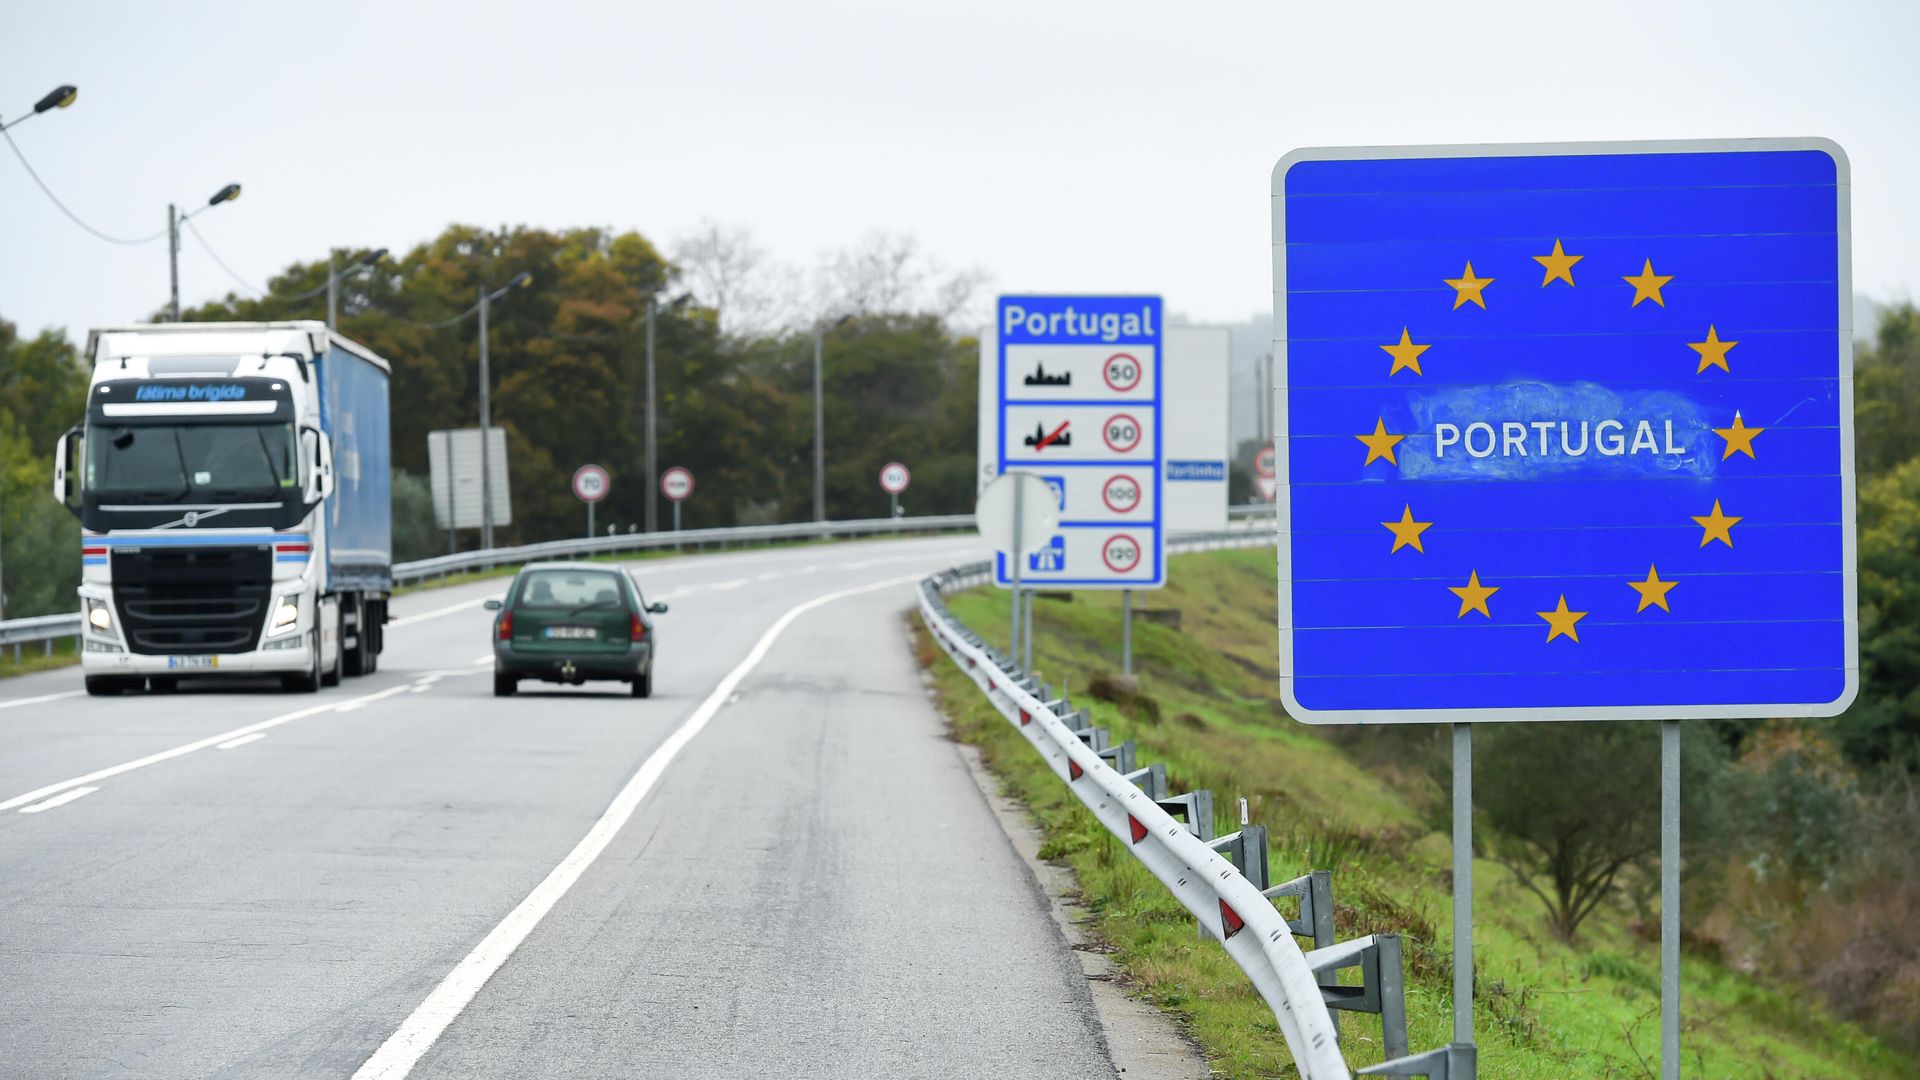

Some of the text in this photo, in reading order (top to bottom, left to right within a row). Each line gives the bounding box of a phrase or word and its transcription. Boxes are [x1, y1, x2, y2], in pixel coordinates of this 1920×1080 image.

[1004, 305, 1155, 341] Portugal
[1109, 364, 1135, 380] 50
[1109, 425, 1135, 441] 90
[1435, 419, 1686, 458] PORTUGAL
[1109, 487, 1136, 500] 100
[1109, 547, 1136, 560] 120
